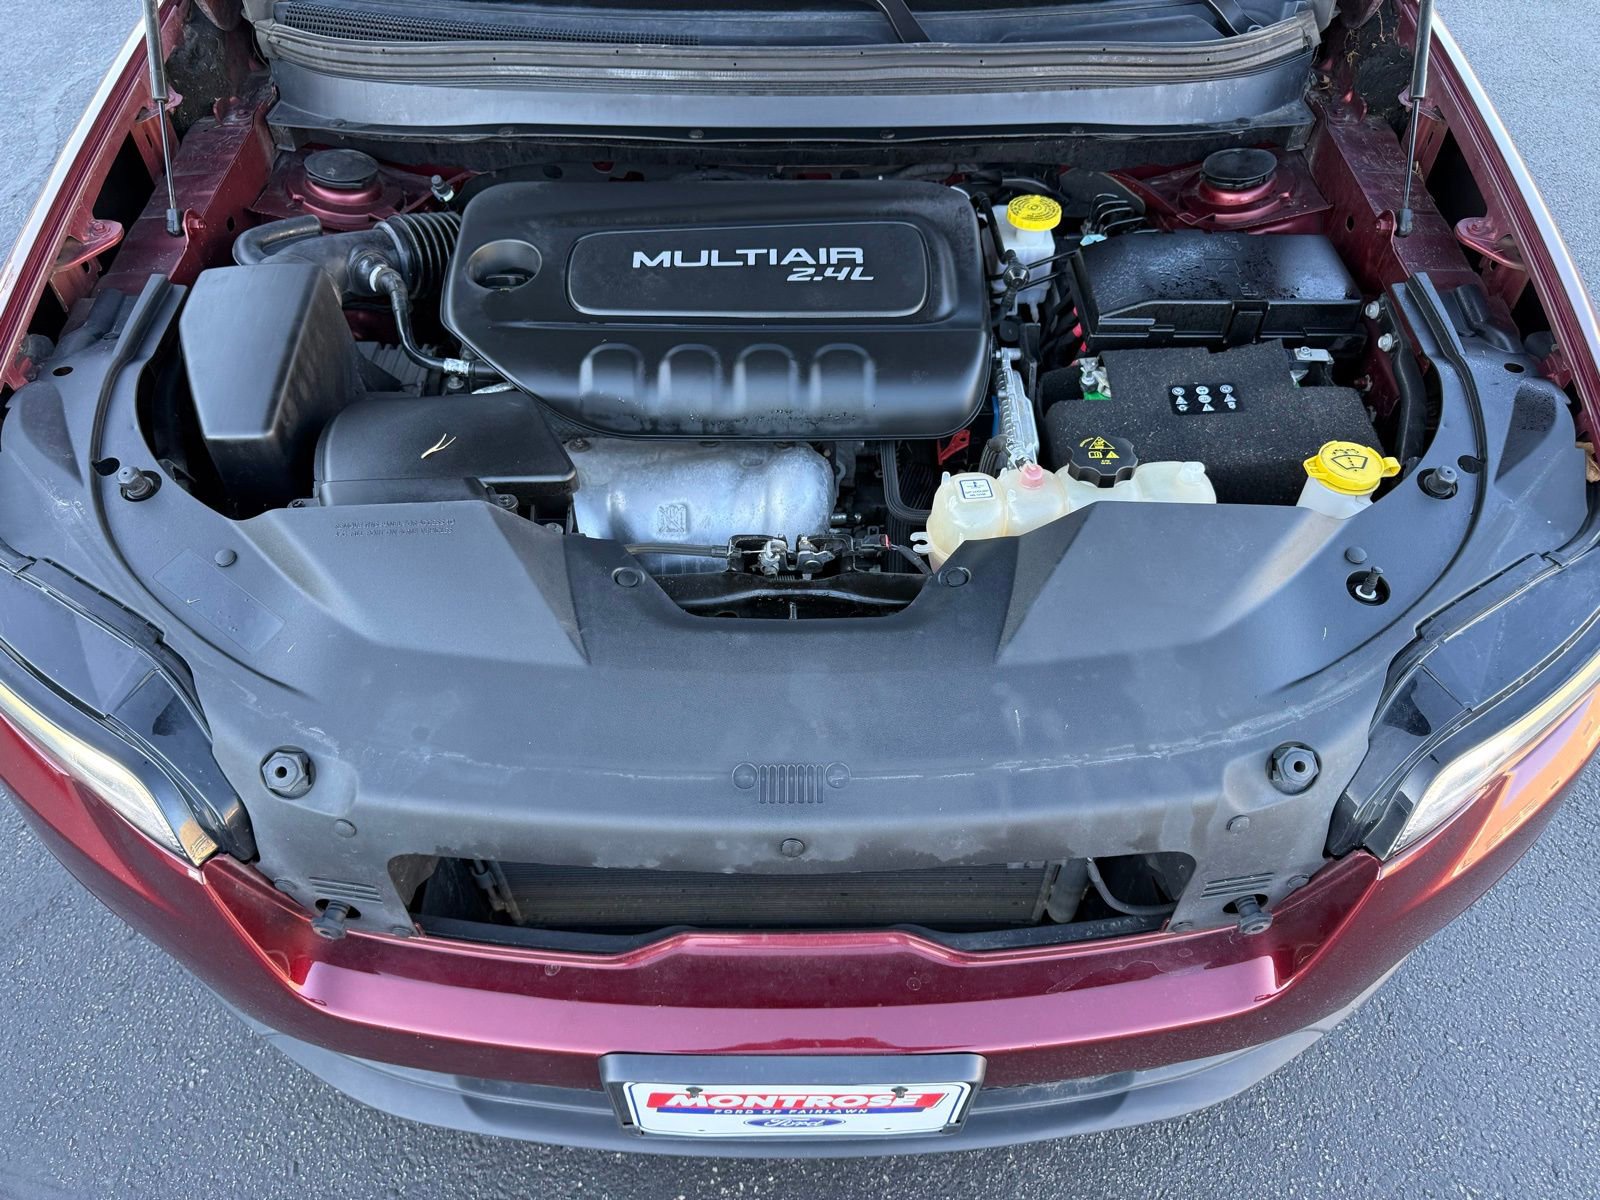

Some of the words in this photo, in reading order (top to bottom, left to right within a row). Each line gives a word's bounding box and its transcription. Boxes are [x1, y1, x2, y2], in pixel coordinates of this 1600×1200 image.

[632, 248, 864, 268] MULTIAIR
[787, 267, 874, 281] 2.4L
[664, 1094, 923, 1107] MONTROSE
[763, 1117, 825, 1127] Ford
